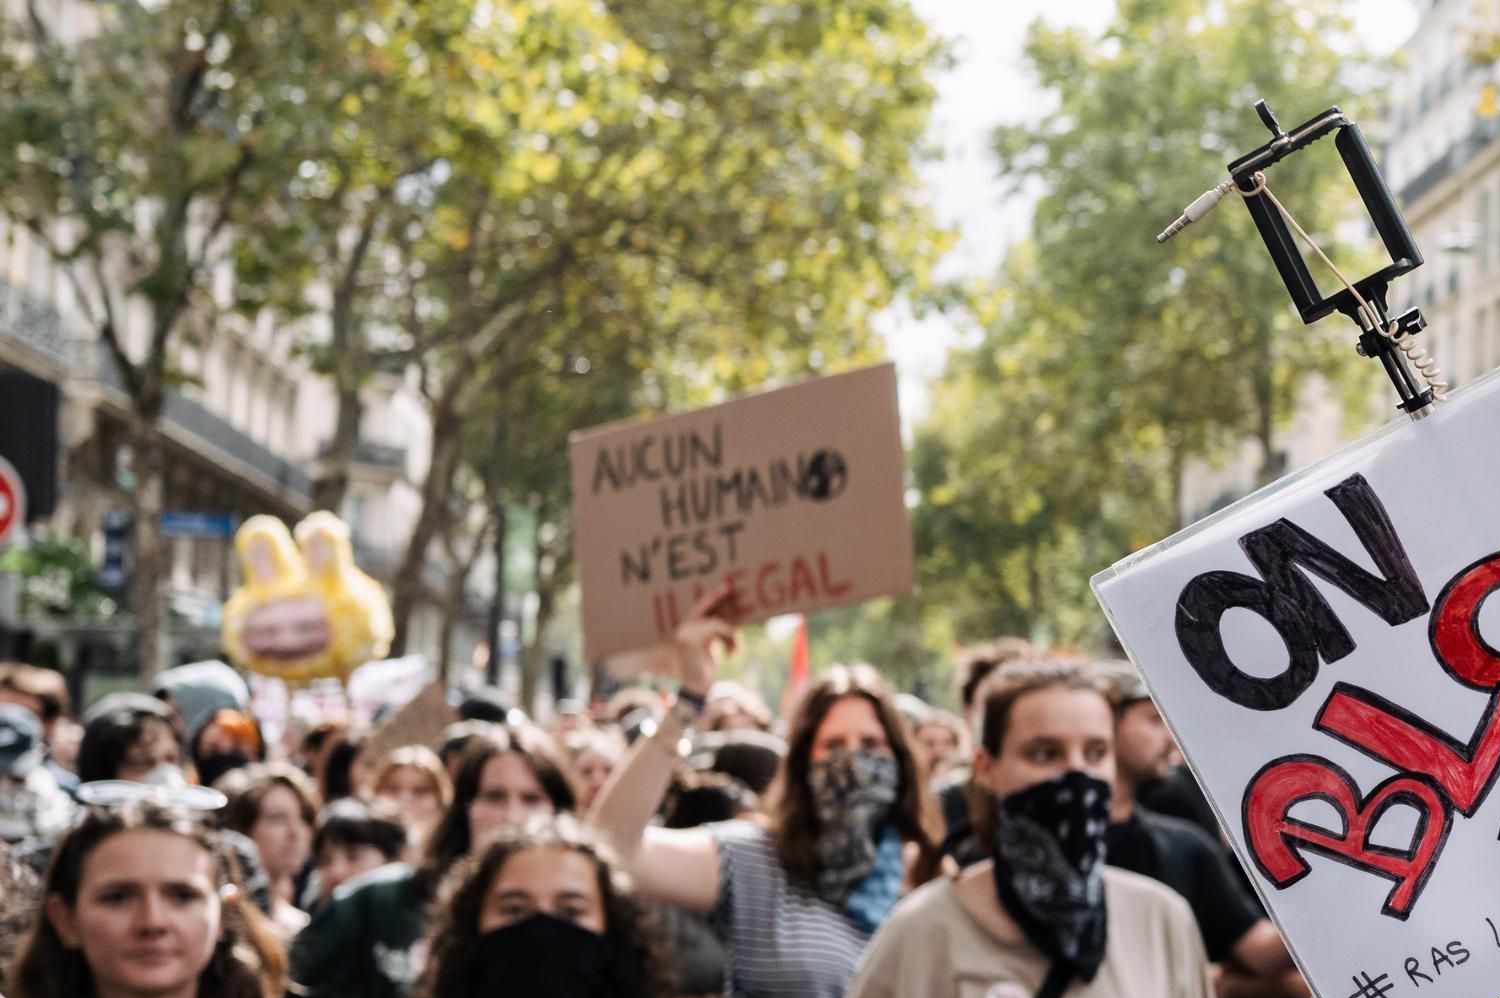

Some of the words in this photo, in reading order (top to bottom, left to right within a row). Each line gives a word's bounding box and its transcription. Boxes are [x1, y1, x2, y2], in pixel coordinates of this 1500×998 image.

[592, 422, 724, 496] AUCUN
[660, 453, 808, 527] HUMAIN
[620, 522, 745, 586] N'EST
[653, 552, 853, 639] ILEGAL
[1174, 472, 1429, 711] ON
